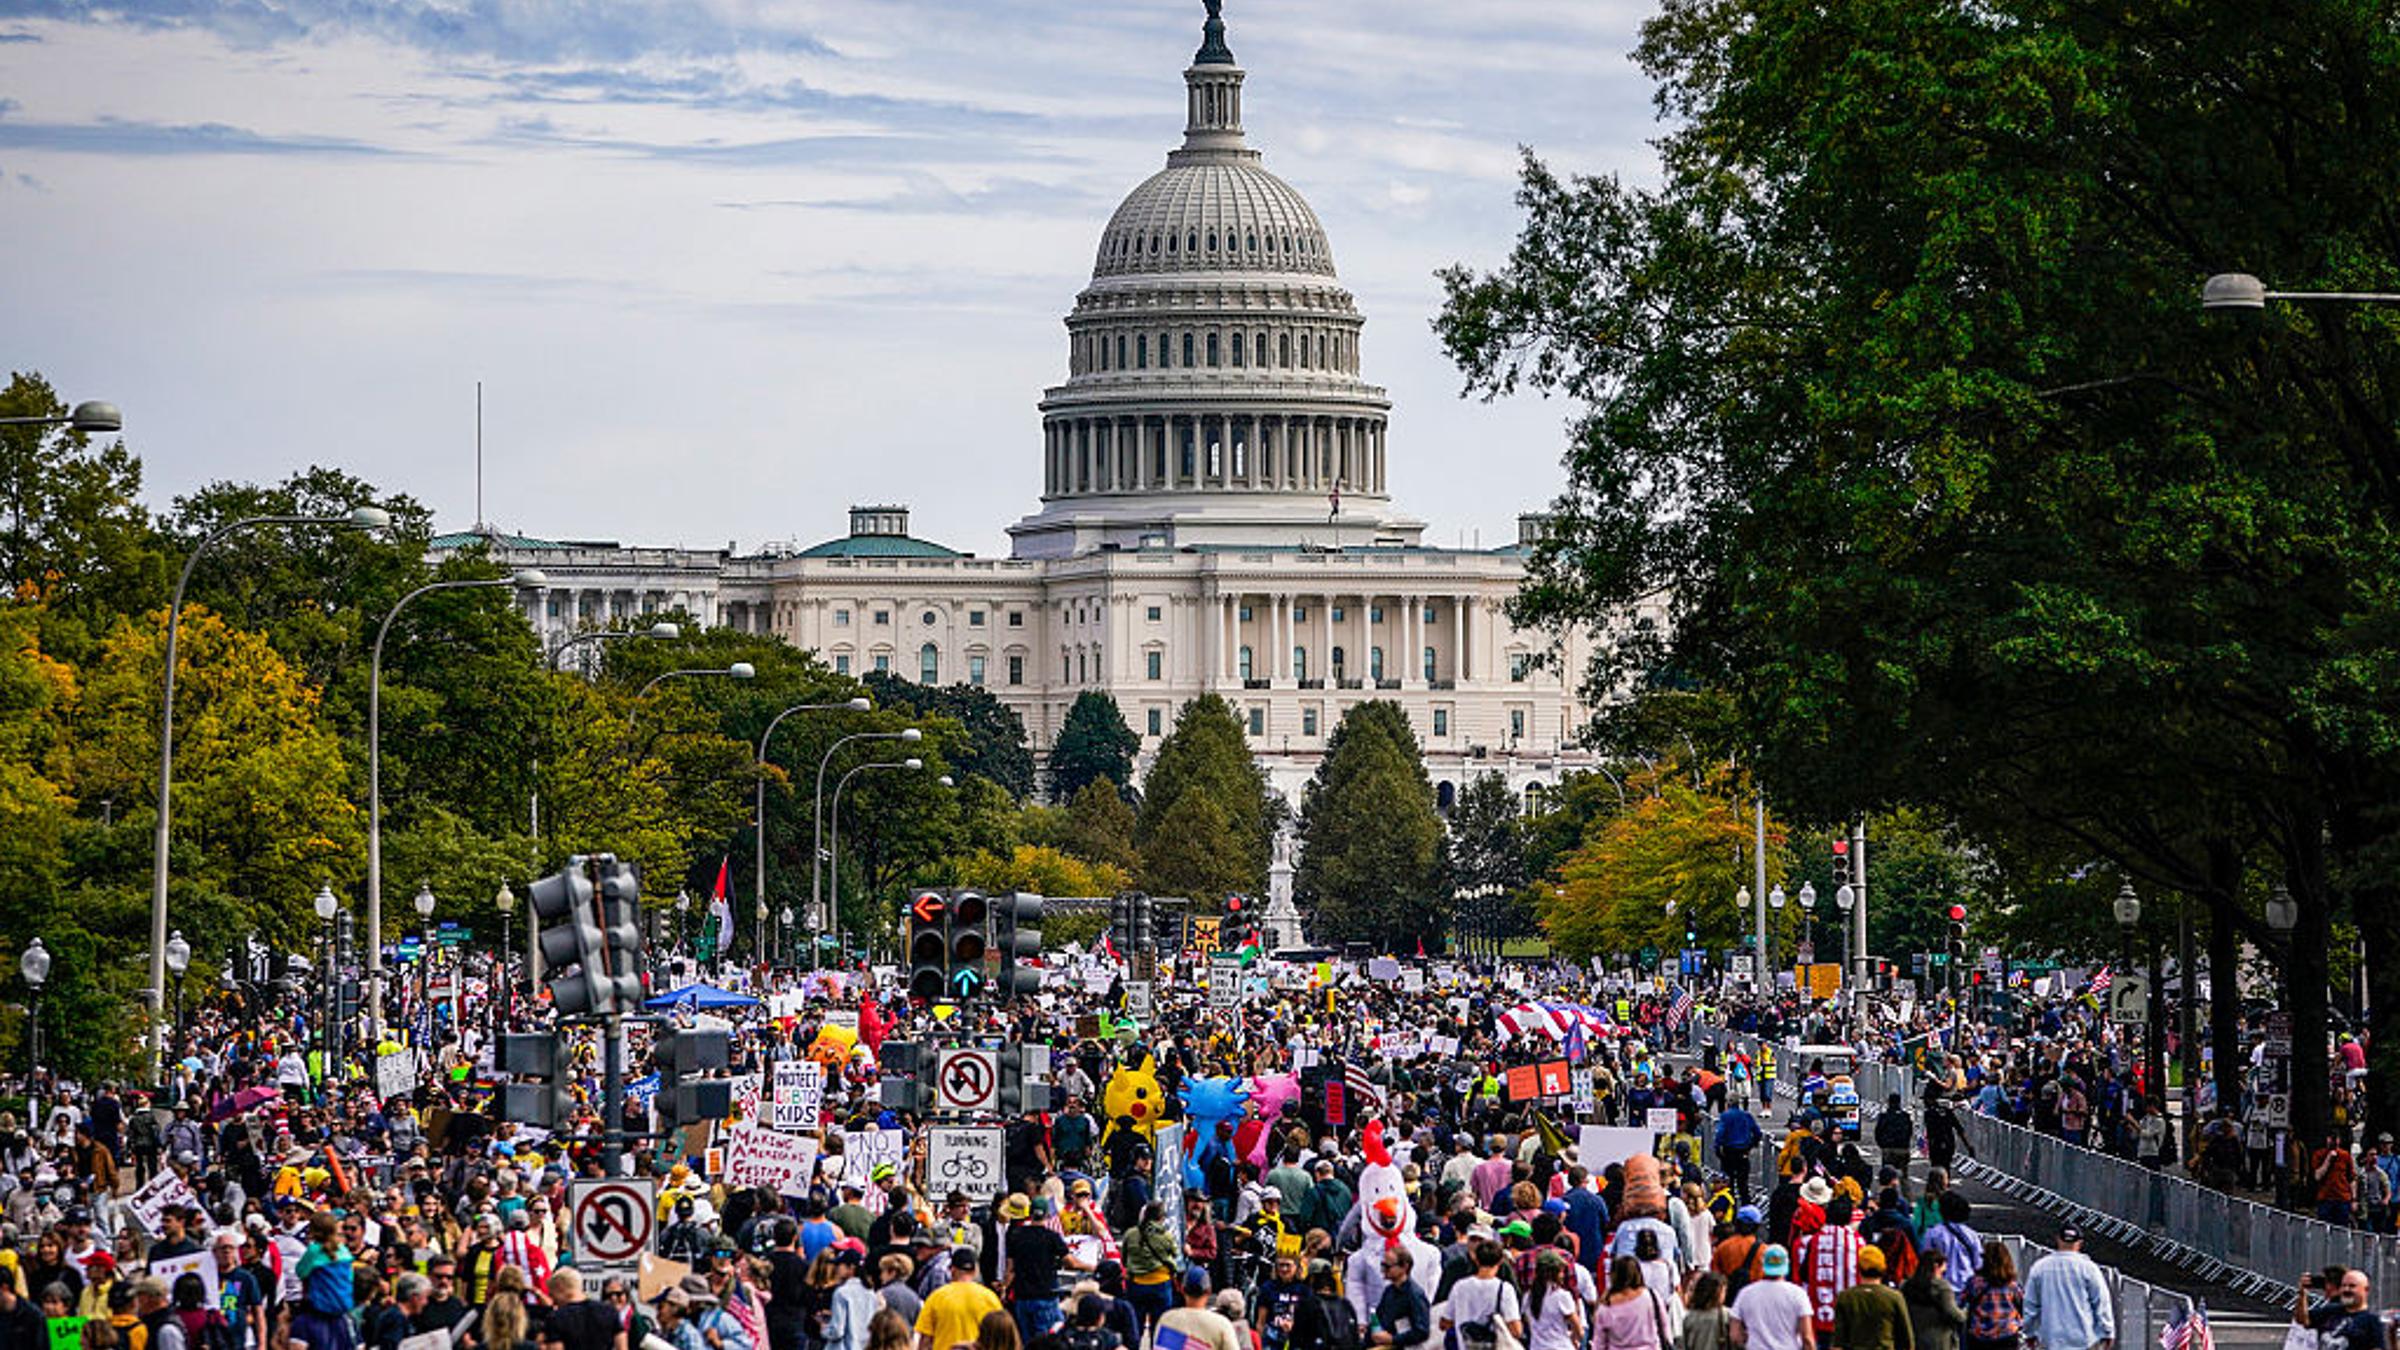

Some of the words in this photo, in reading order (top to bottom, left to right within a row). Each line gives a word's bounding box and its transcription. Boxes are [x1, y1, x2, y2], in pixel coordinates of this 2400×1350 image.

[2116, 1009, 2143, 1020] ONLY
[777, 1072, 818, 1088] PROTECT
[775, 1089, 820, 1104] LGBTQ
[775, 1105, 816, 1123] KIDS
[732, 1127, 793, 1149] MAKING
[860, 1131, 889, 1152] NO
[944, 1135, 988, 1148] TURNING
[732, 1159, 791, 1180] GESTAPO
[1817, 1224, 1835, 1282] FREE
[1817, 1286, 1835, 1322] DC
[56, 1321, 79, 1338] the
